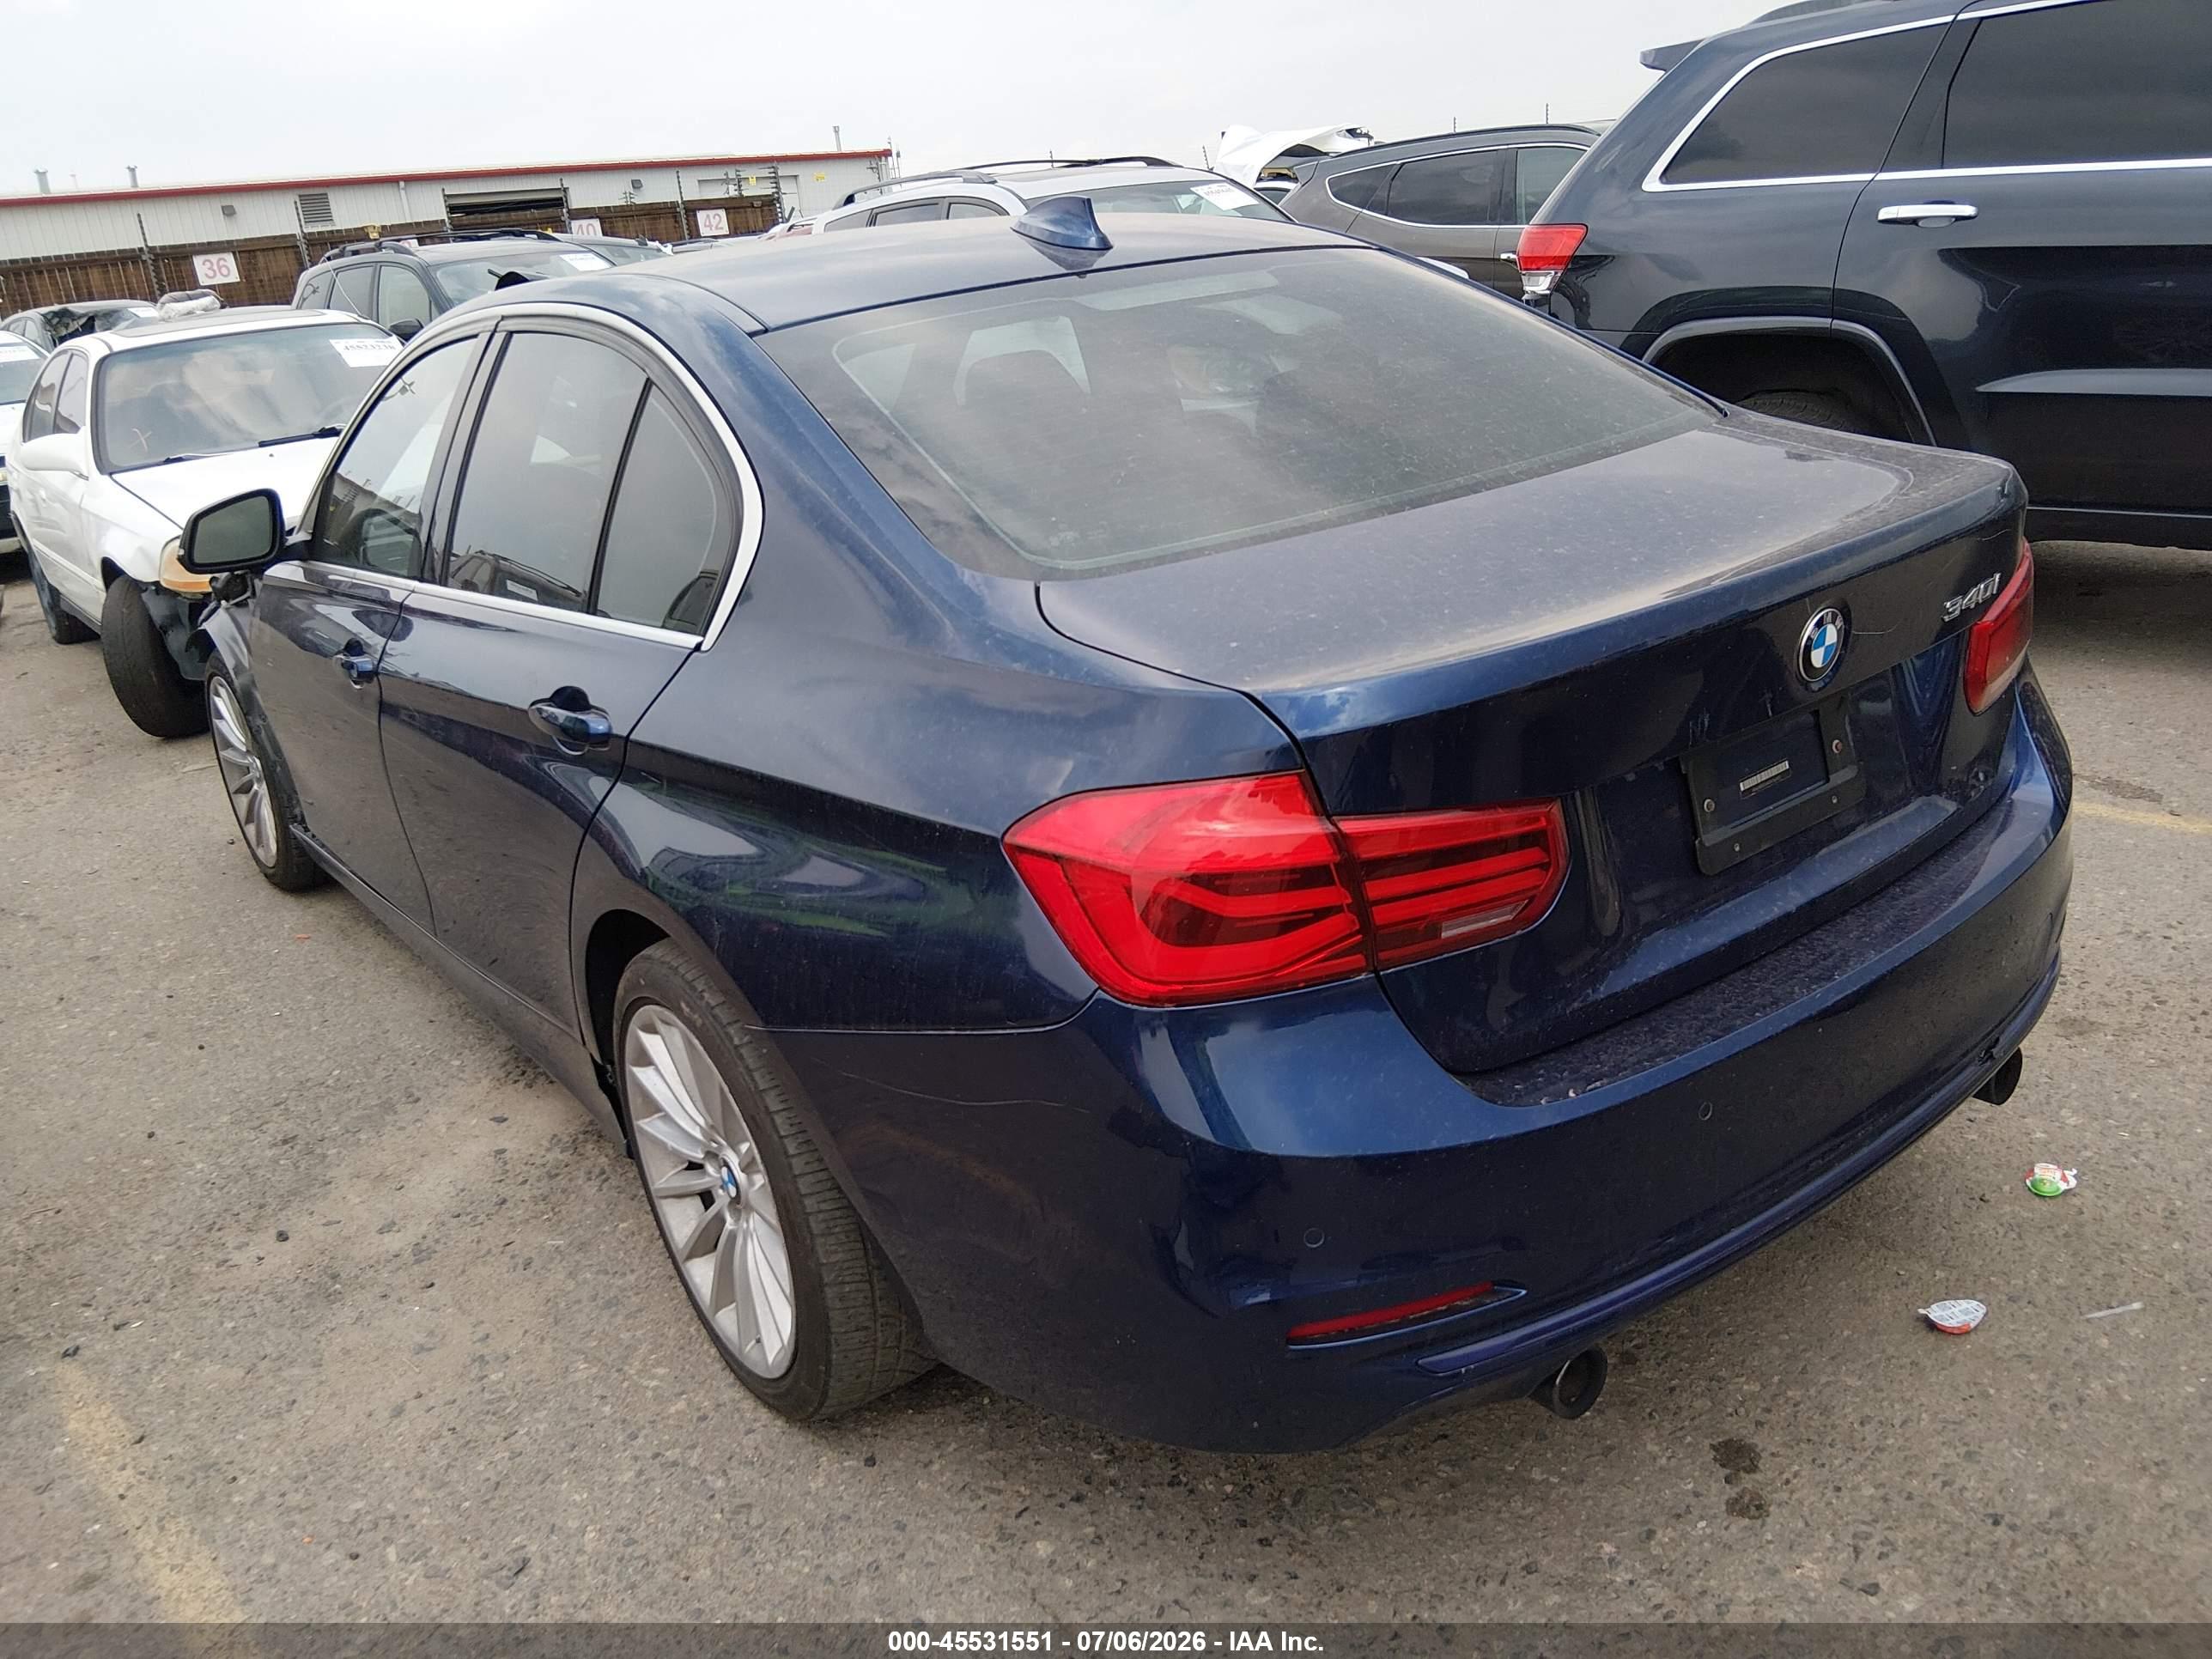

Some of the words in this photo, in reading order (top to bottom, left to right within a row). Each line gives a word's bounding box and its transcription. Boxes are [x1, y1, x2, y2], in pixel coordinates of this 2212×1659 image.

[704, 213, 724, 231] 42
[202, 258, 231, 279] 36
[1942, 572, 2002, 622] 340i
